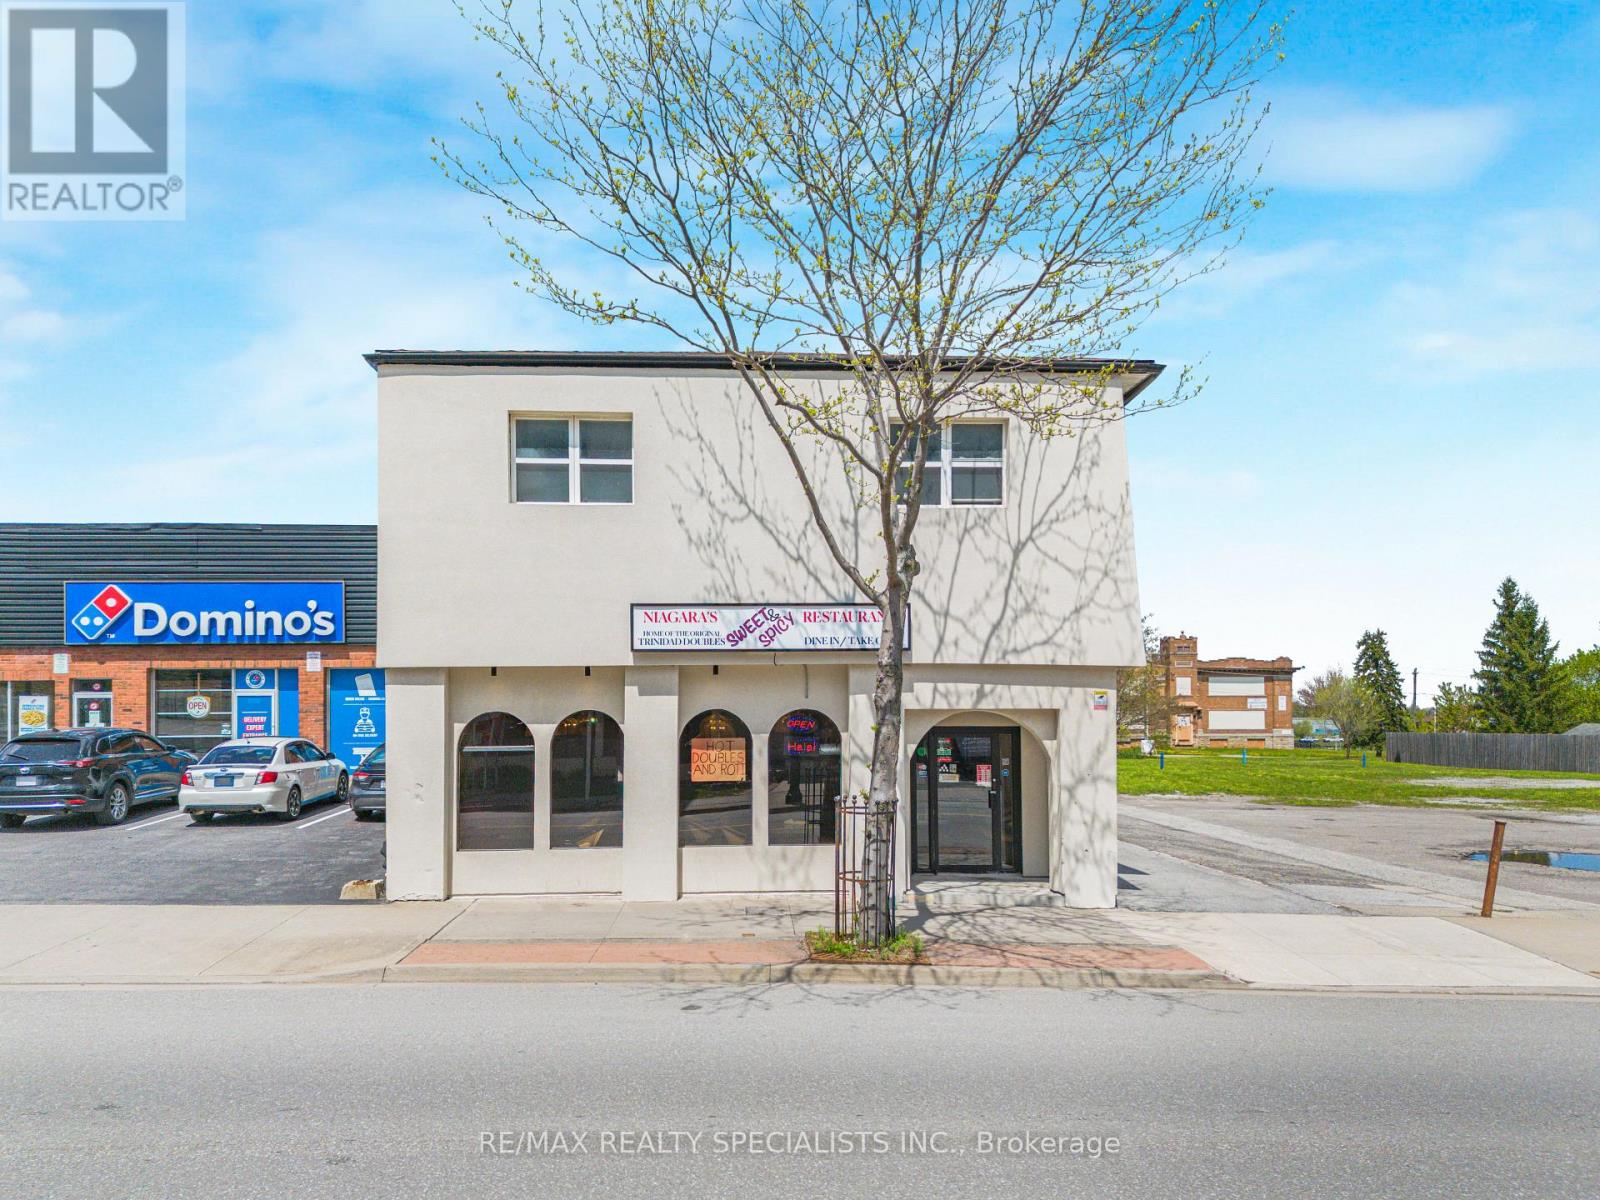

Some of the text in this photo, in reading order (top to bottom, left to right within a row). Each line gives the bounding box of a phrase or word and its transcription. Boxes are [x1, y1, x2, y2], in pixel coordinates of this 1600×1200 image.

[134, 599, 335, 637] Domino's
[643, 610, 718, 623] NIAGARA'S
[767, 608, 780, 622] &
[803, 610, 885, 623] RESTAURAN
[726, 607, 770, 647] SWEET
[758, 611, 795, 647] SPICY
[638, 638, 726, 646] TRINIDAD DOUBLES
[804, 636, 828, 645] DINE
[829, 636, 840, 645] IN
[848, 636, 874, 645] TAKE
[188, 701, 208, 710] OPEN
[786, 719, 816, 729] OPEN
[706, 740, 736, 751] HOT
[692, 751, 745, 764] DOUBLES
[693, 763, 745, 775] AND ROTI
